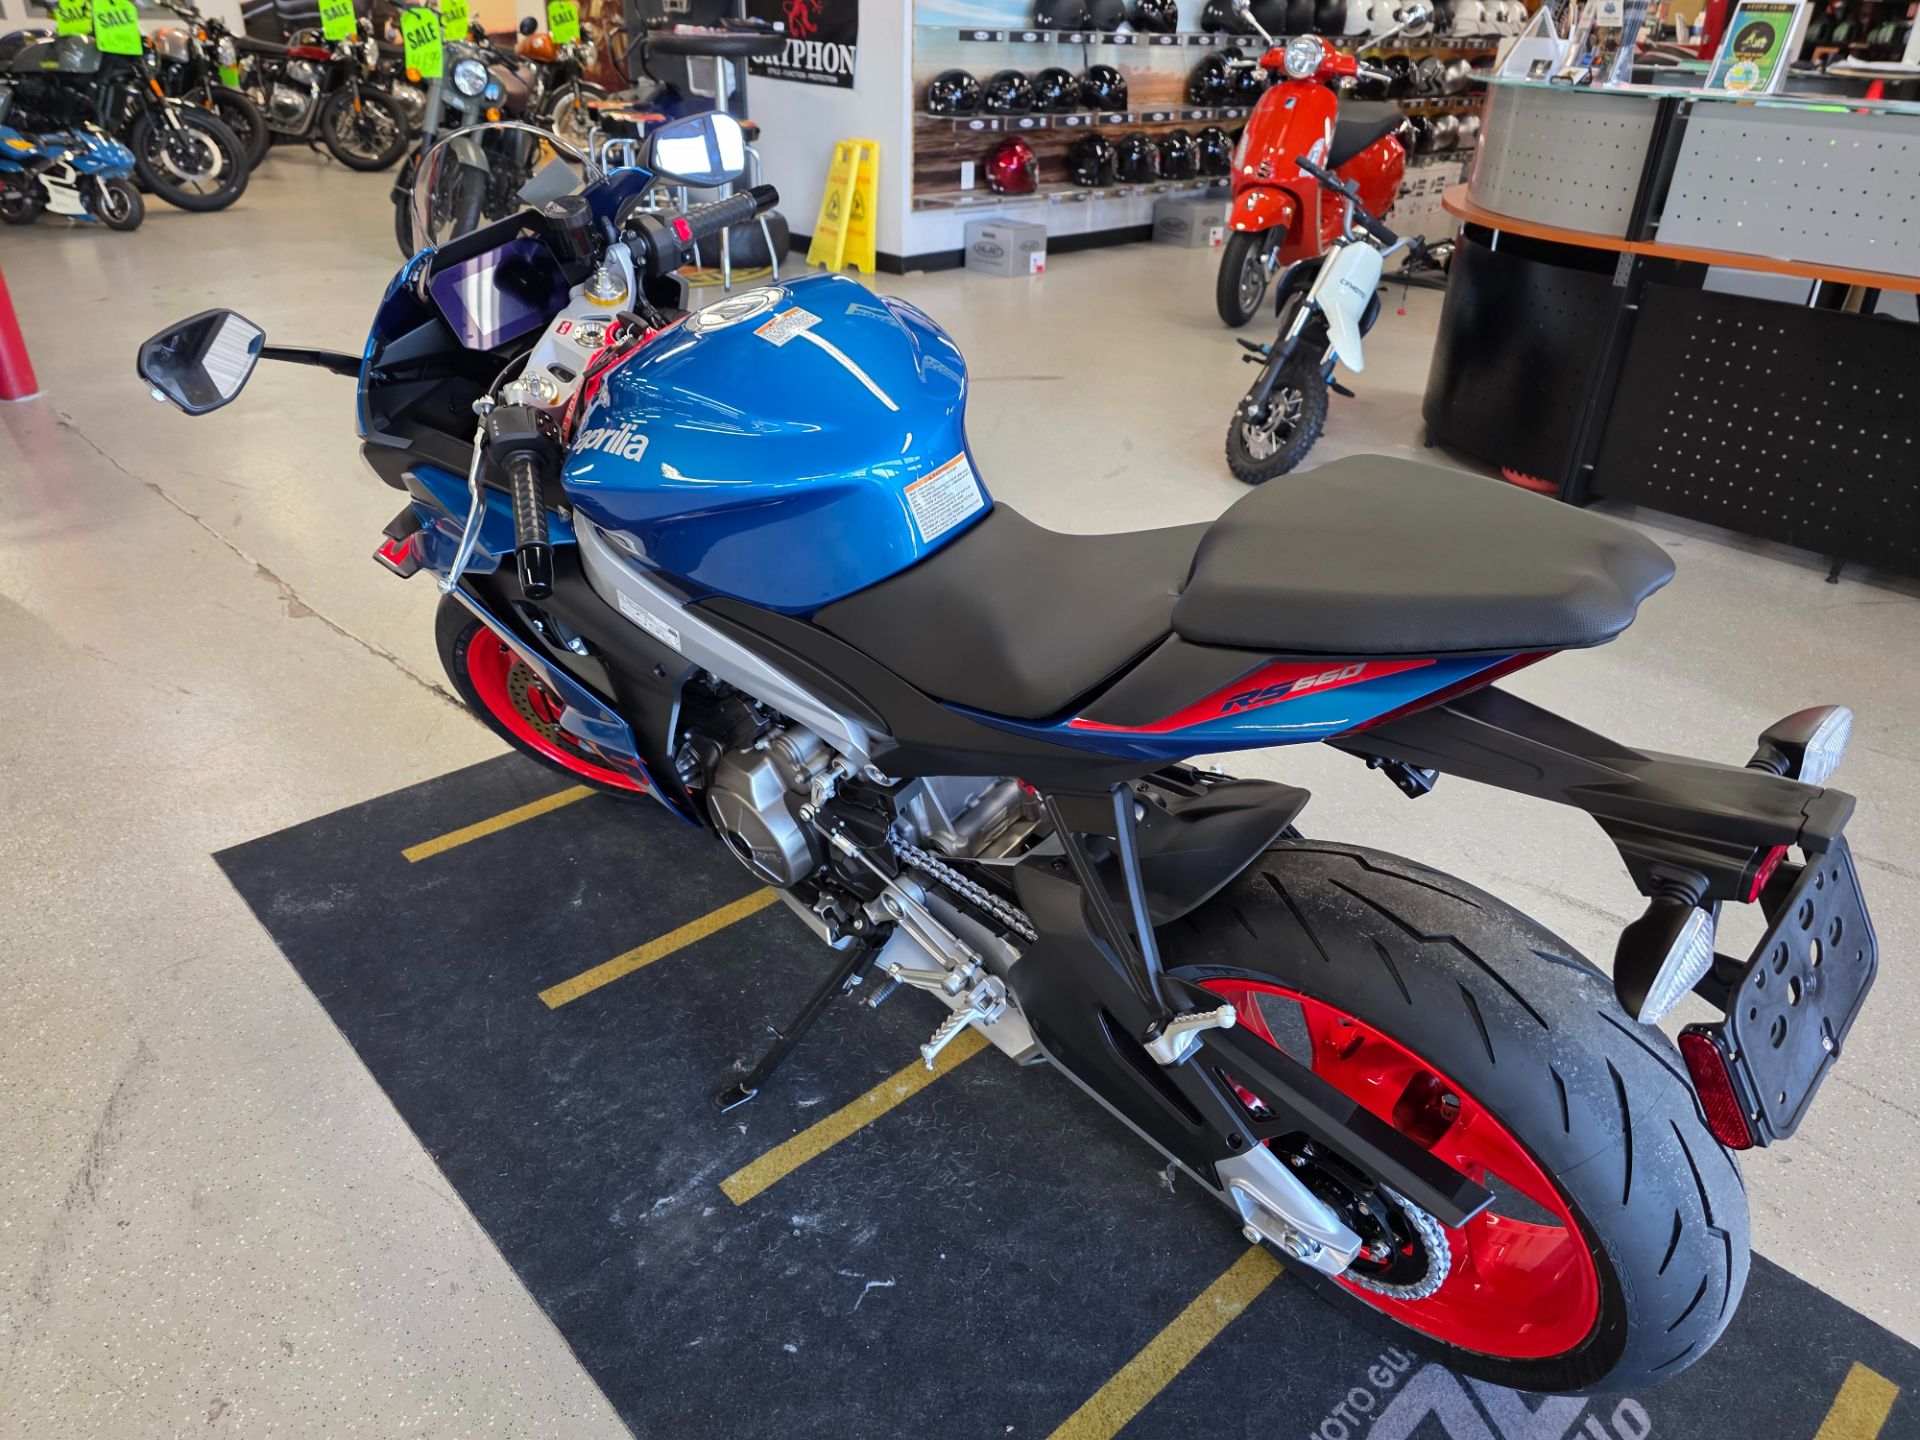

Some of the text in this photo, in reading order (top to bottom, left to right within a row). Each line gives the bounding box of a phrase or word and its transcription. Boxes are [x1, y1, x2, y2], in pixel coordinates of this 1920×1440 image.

[97, 9, 134, 28] SALE
[323, 3, 350, 21] SALE
[552, 10, 574, 26] SALE
[406, 22, 438, 49] SALE
[572, 422, 649, 462] aprilia
